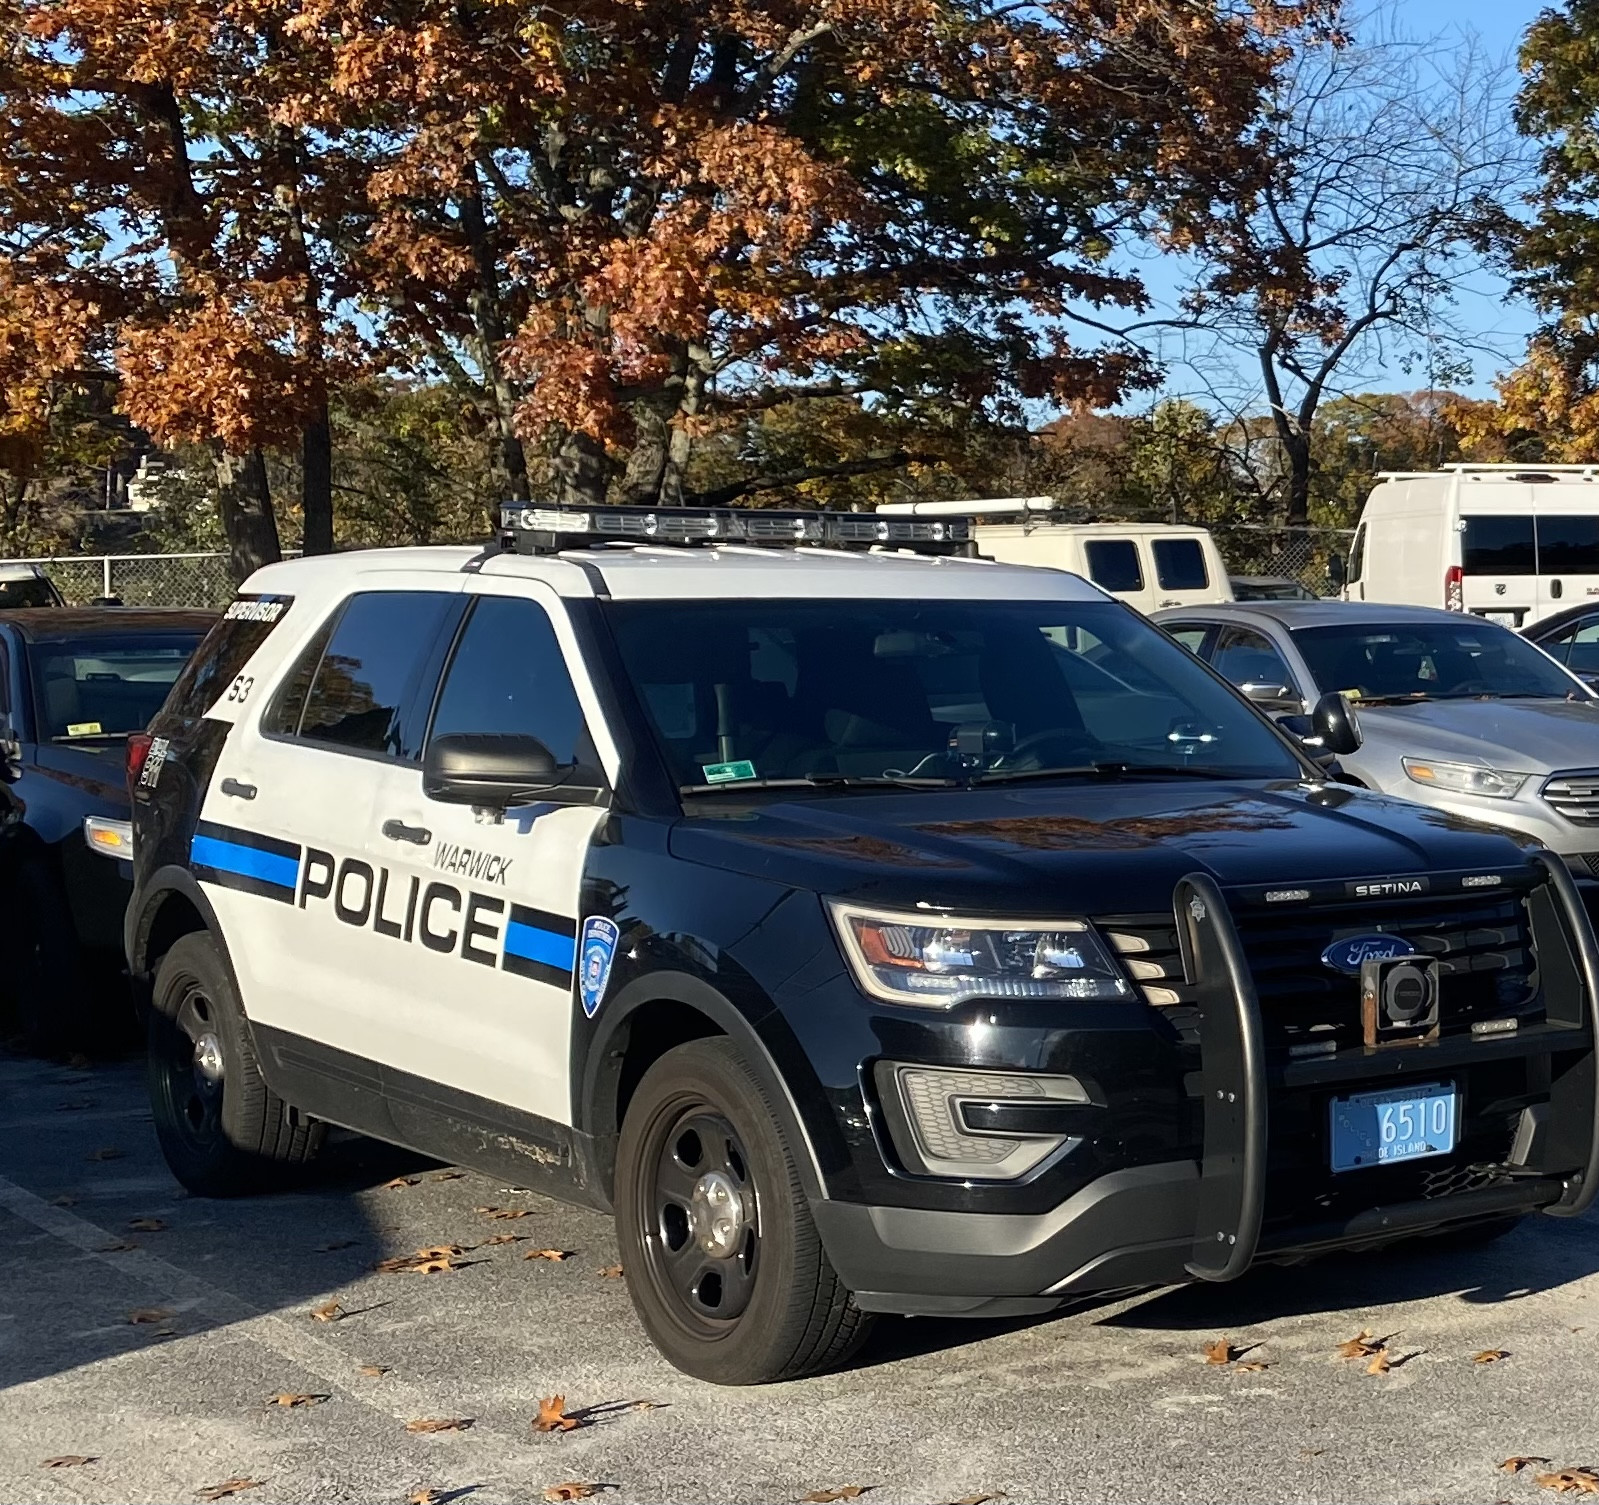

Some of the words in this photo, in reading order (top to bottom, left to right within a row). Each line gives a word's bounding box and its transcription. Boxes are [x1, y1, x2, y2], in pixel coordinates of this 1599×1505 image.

[223, 601, 284, 622] SUPERVISOR
[228, 675, 255, 703] S3
[433, 841, 513, 885] WARWICK
[1355, 881, 1423, 897] SETINA
[299, 846, 505, 968] POLICE
[1347, 941, 1397, 965] Ford
[1383, 1099, 1448, 1143] 6510
[1394, 1140, 1427, 1156] ISLAND
